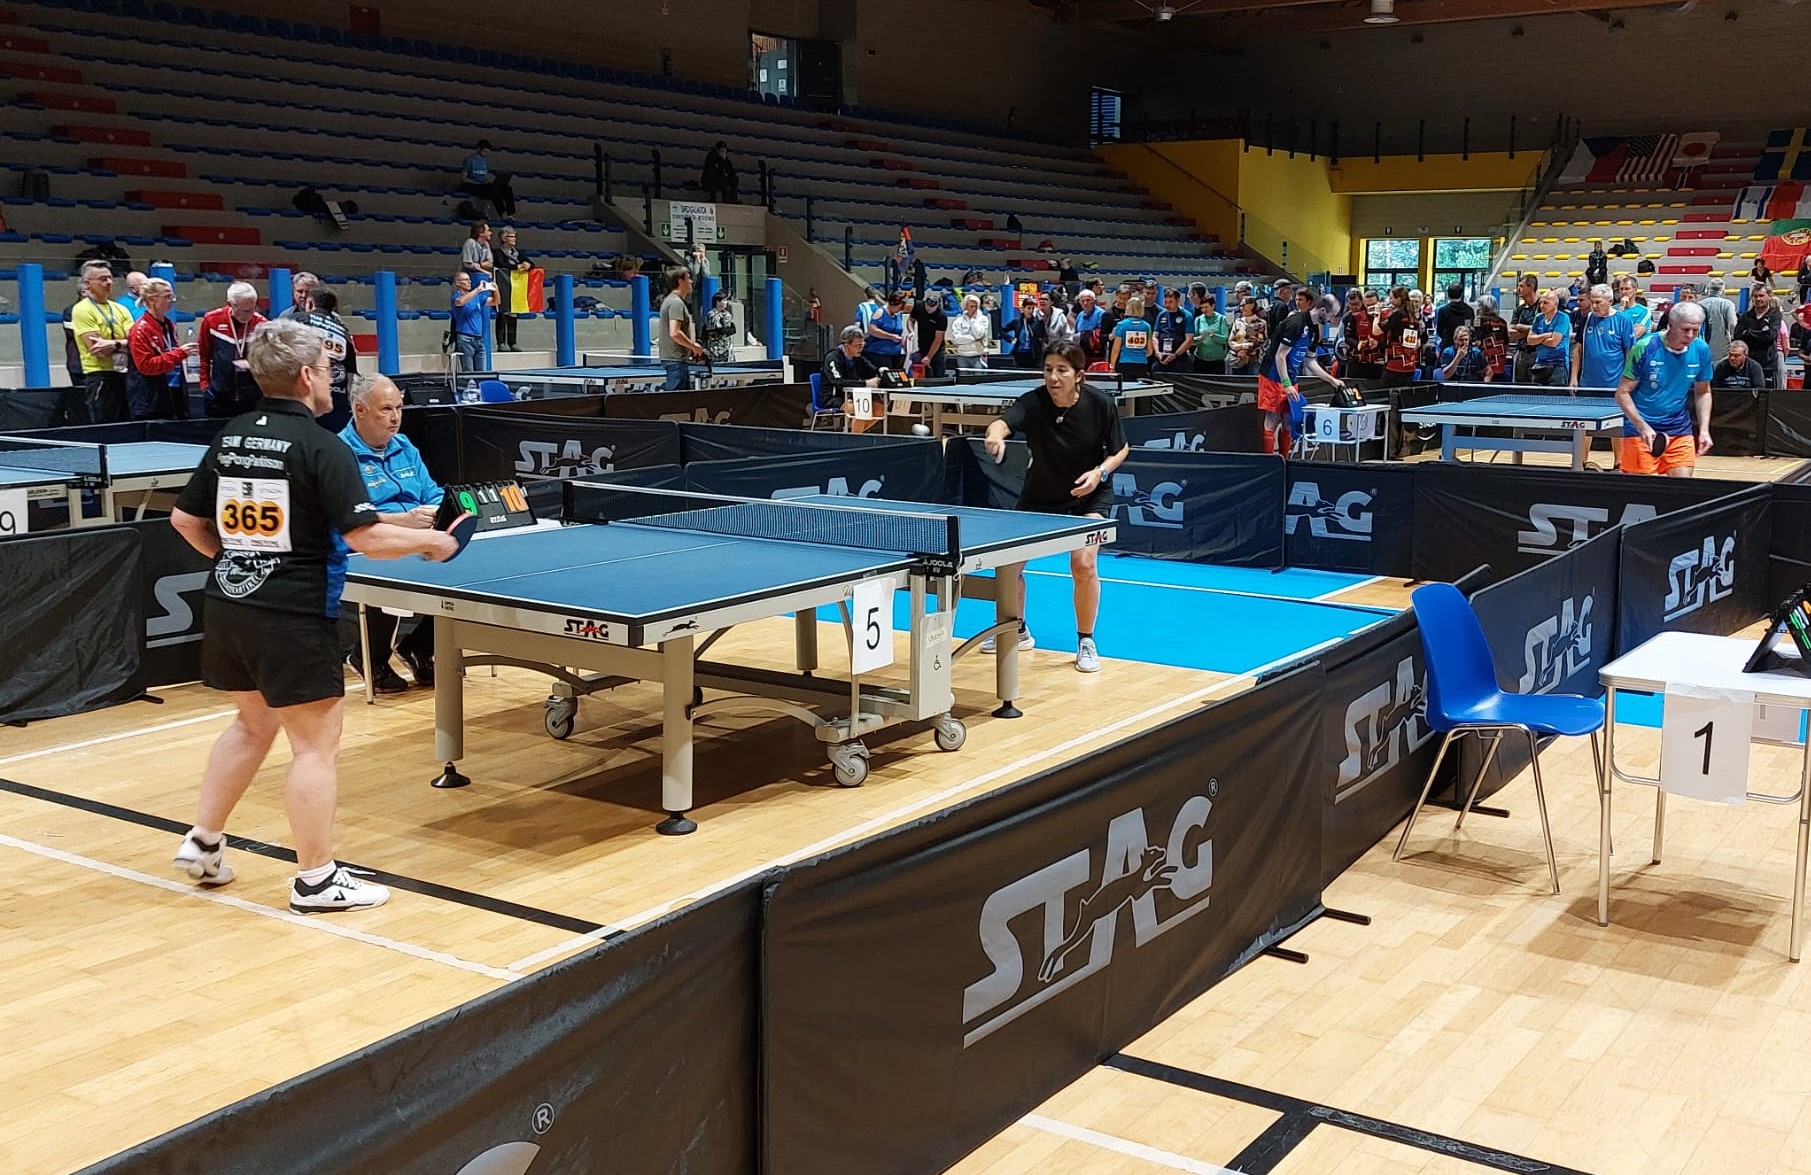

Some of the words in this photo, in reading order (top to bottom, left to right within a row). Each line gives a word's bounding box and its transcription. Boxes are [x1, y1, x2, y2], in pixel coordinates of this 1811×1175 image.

[857, 399, 869, 413] 10
[1323, 419, 1332, 435] 6
[1561, 421, 1585, 429] STAG
[244, 437, 292, 453] GERMANY
[500, 485, 527, 512] 10
[0, 510, 16, 535] 9
[223, 504, 279, 531] 365
[1085, 531, 1108, 546] STAG
[563, 618, 610, 641] STAG
[866, 606, 881, 650] 5
[1694, 721, 1714, 775] 1
